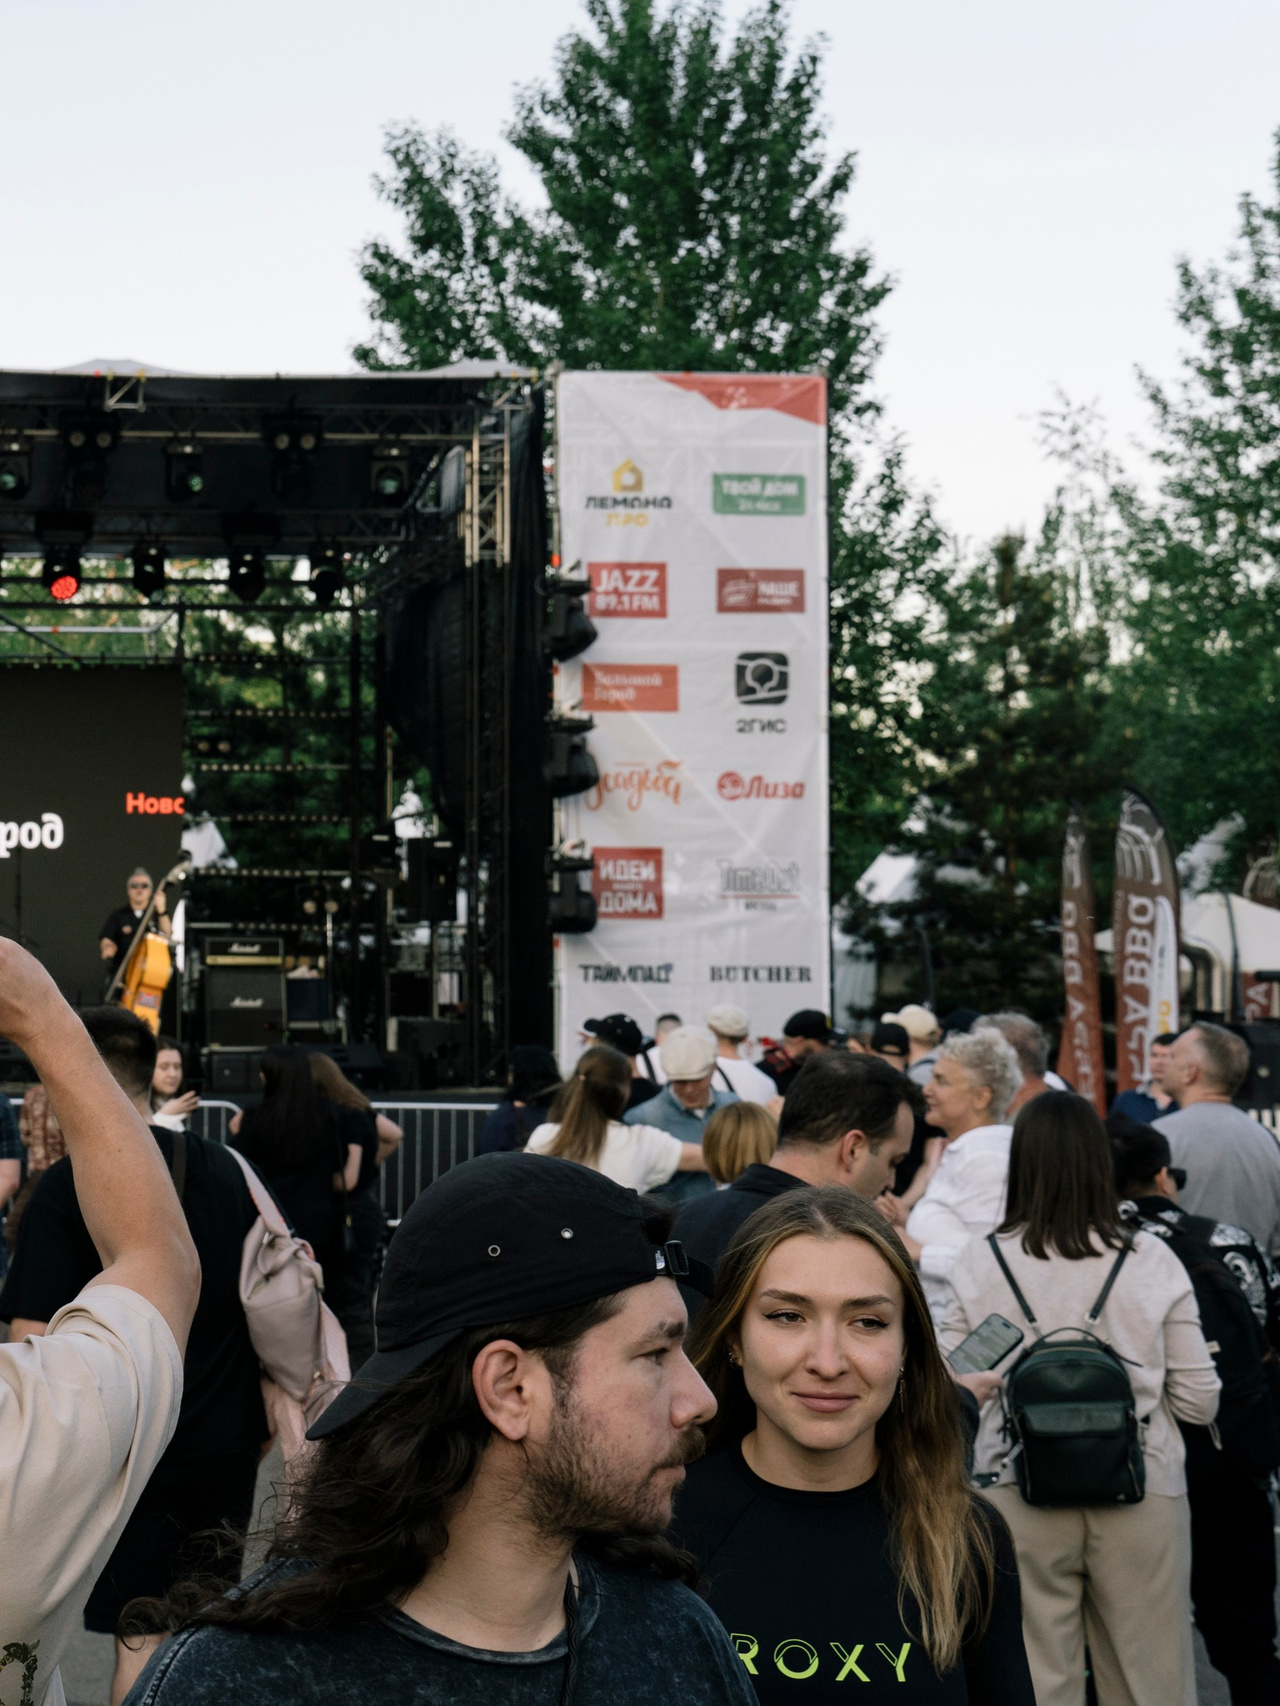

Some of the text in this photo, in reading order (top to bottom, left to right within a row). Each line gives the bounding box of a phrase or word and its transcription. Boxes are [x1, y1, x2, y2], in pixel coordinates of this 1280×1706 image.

[596, 568, 660, 593] JAZZ
[595, 594, 661, 611] 89.1 FM
[736, 719, 786, 733] 2ГИС
[745, 774, 805, 799] Лиза
[599, 859, 656, 881] ИДЕИ
[598, 891, 658, 913] ДОМА
[710, 965, 811, 982] BUTCHER
[730, 1632, 912, 1683] ROXY
